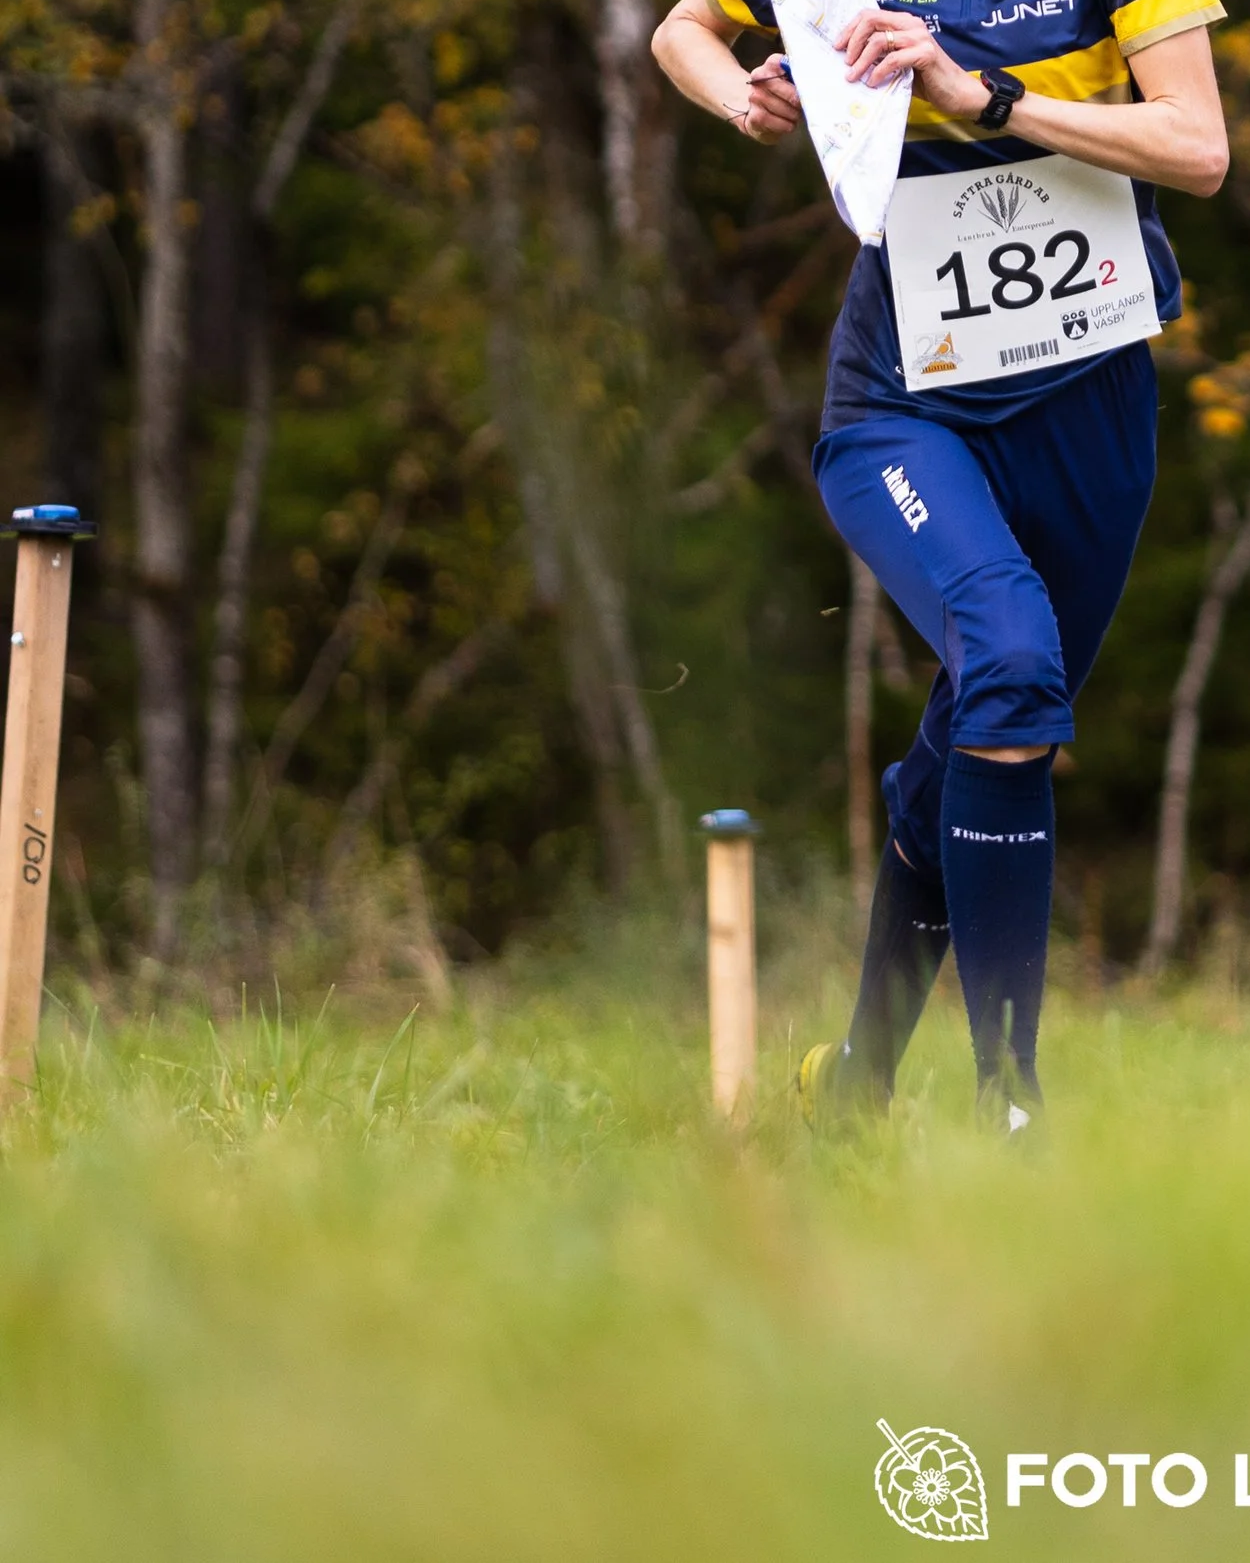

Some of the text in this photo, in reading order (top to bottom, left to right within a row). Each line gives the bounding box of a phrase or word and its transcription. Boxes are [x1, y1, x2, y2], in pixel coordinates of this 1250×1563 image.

[952, 171, 1050, 219] SÄTTRA GÅRD AB
[957, 218, 1055, 242] Lantbruk Entreprenad
[936, 229, 1097, 321] 182
[1098, 259, 1118, 286] 2
[1090, 291, 1146, 318] UPPLANDS
[951, 826, 1048, 843] TRIMTEX
